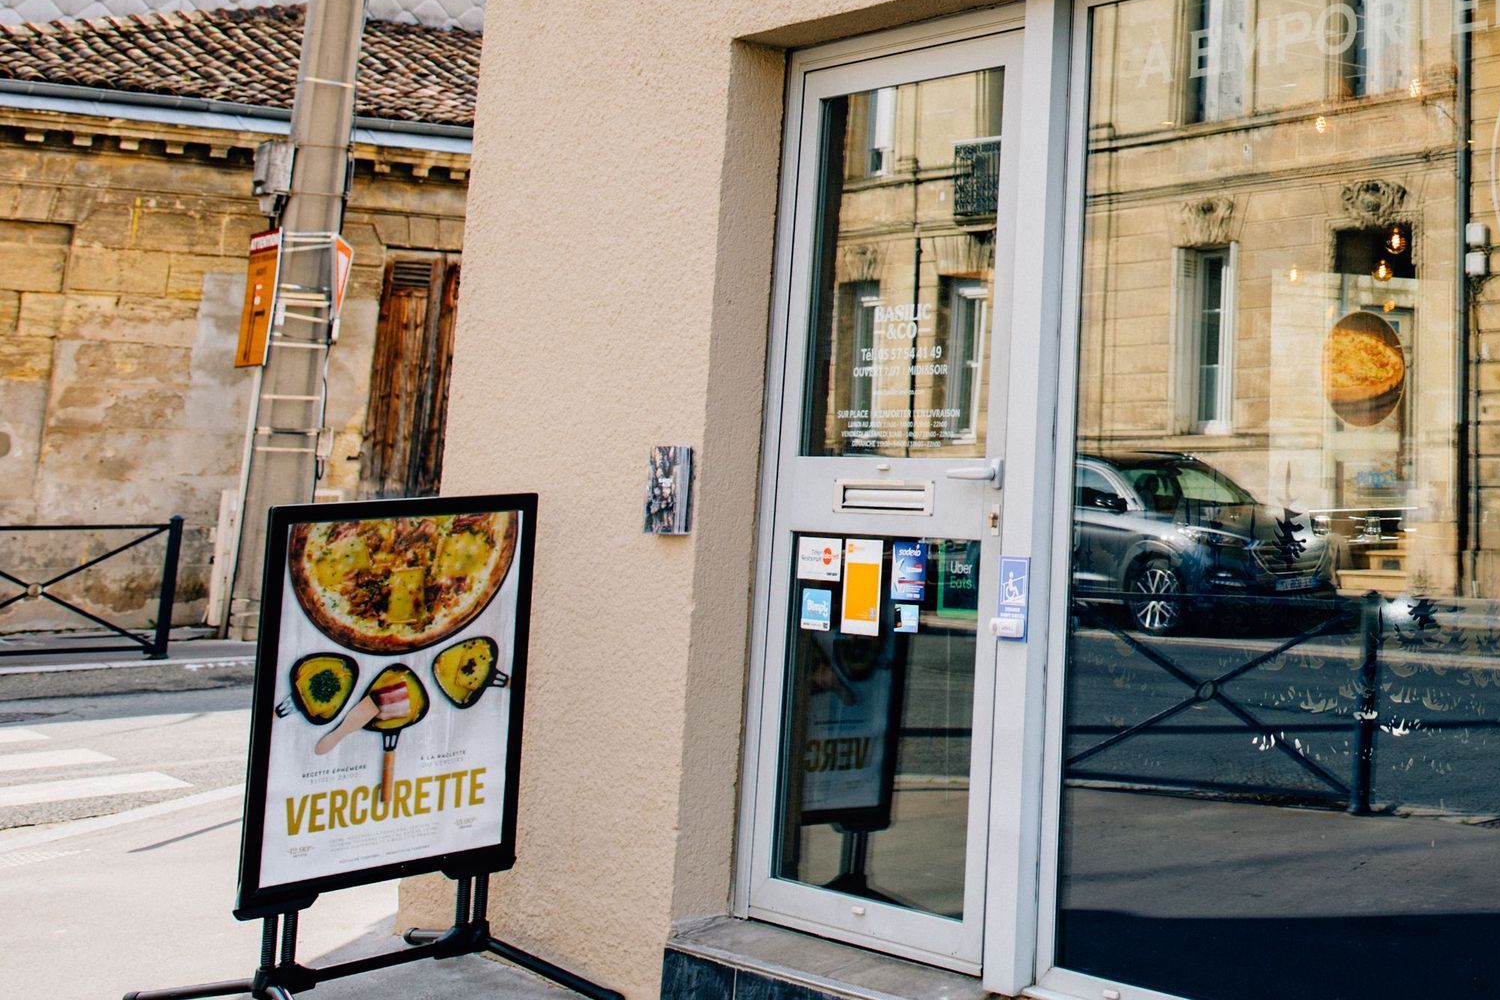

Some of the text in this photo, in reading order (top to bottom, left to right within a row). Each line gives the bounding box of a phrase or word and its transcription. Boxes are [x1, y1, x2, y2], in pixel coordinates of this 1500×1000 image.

[874, 303, 932, 323] BASILIC
[950, 560, 973, 575] Uber
[949, 576, 973, 589] Eats
[285, 767, 487, 837] VERCORETTE
